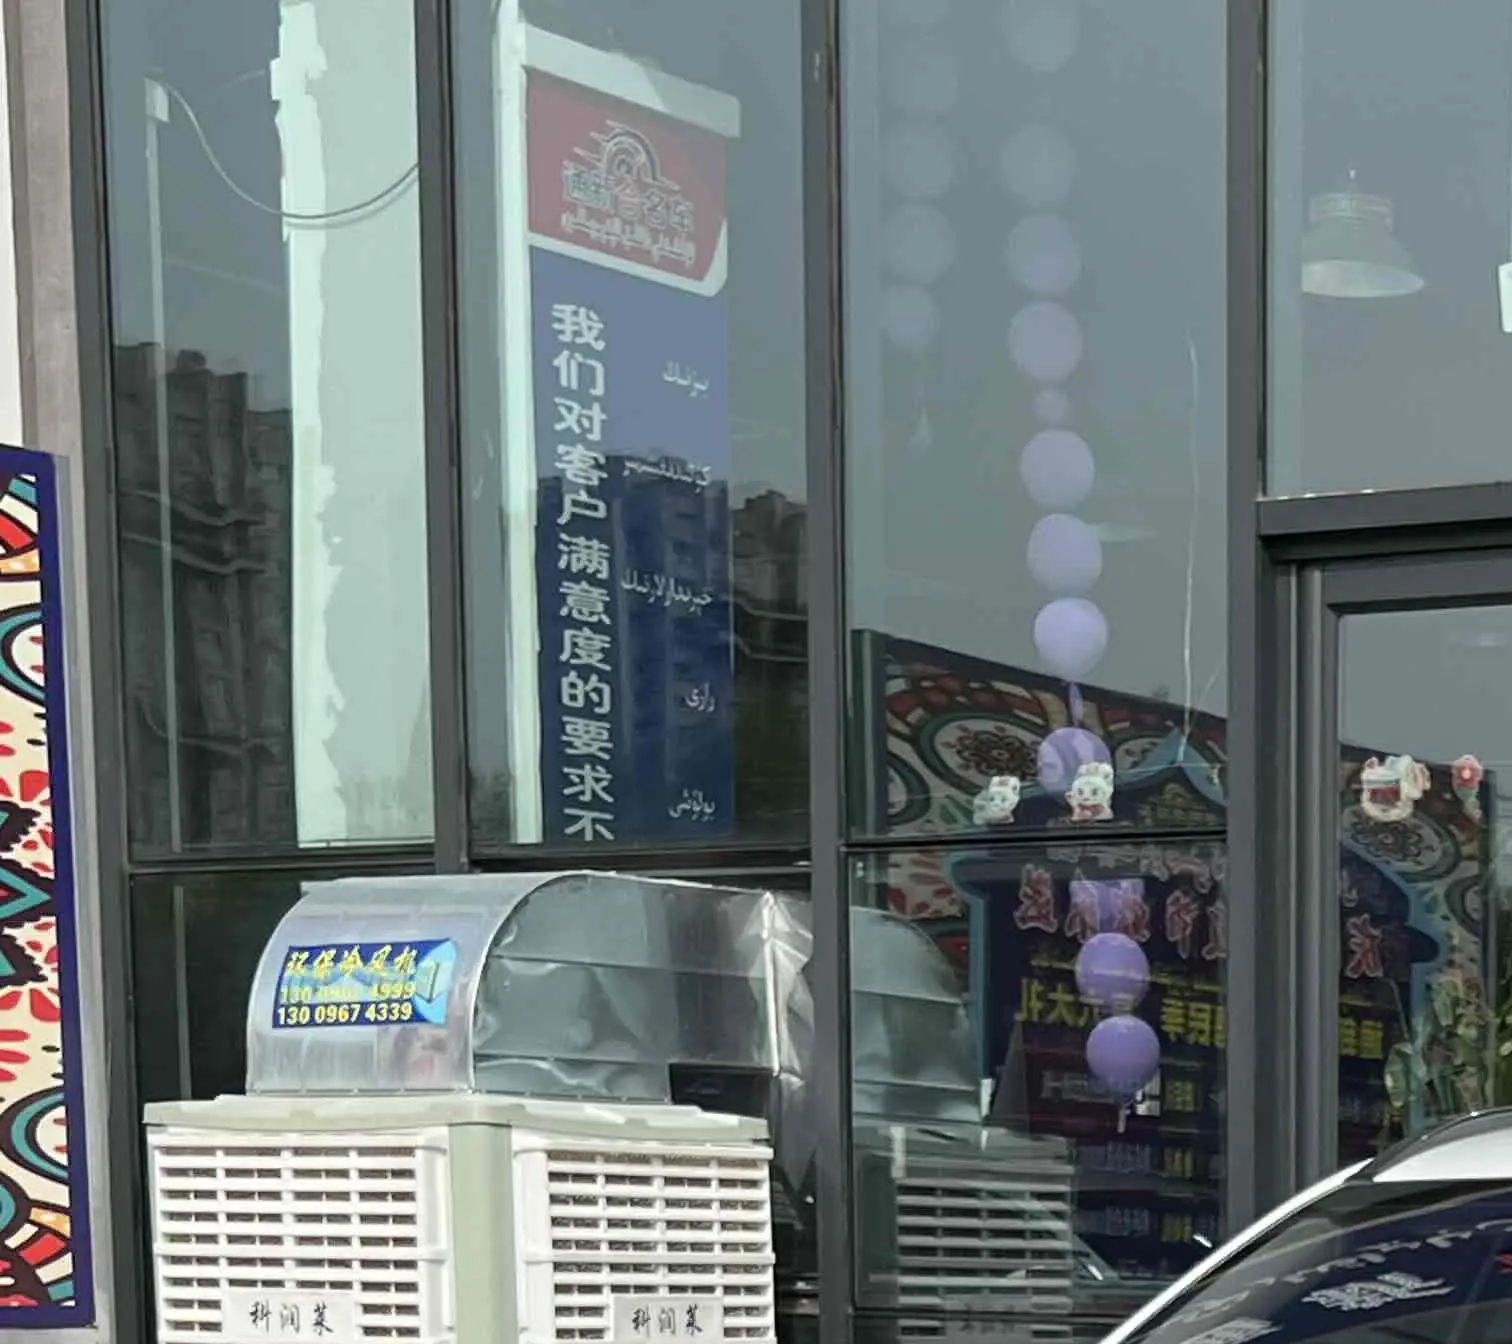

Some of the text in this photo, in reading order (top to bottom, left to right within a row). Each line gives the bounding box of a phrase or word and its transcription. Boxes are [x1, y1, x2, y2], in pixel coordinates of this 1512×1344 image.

[551, 303, 615, 842] 我们对客户满意度的要求不
[278, 1001, 413, 1025] 130 0967 4339
